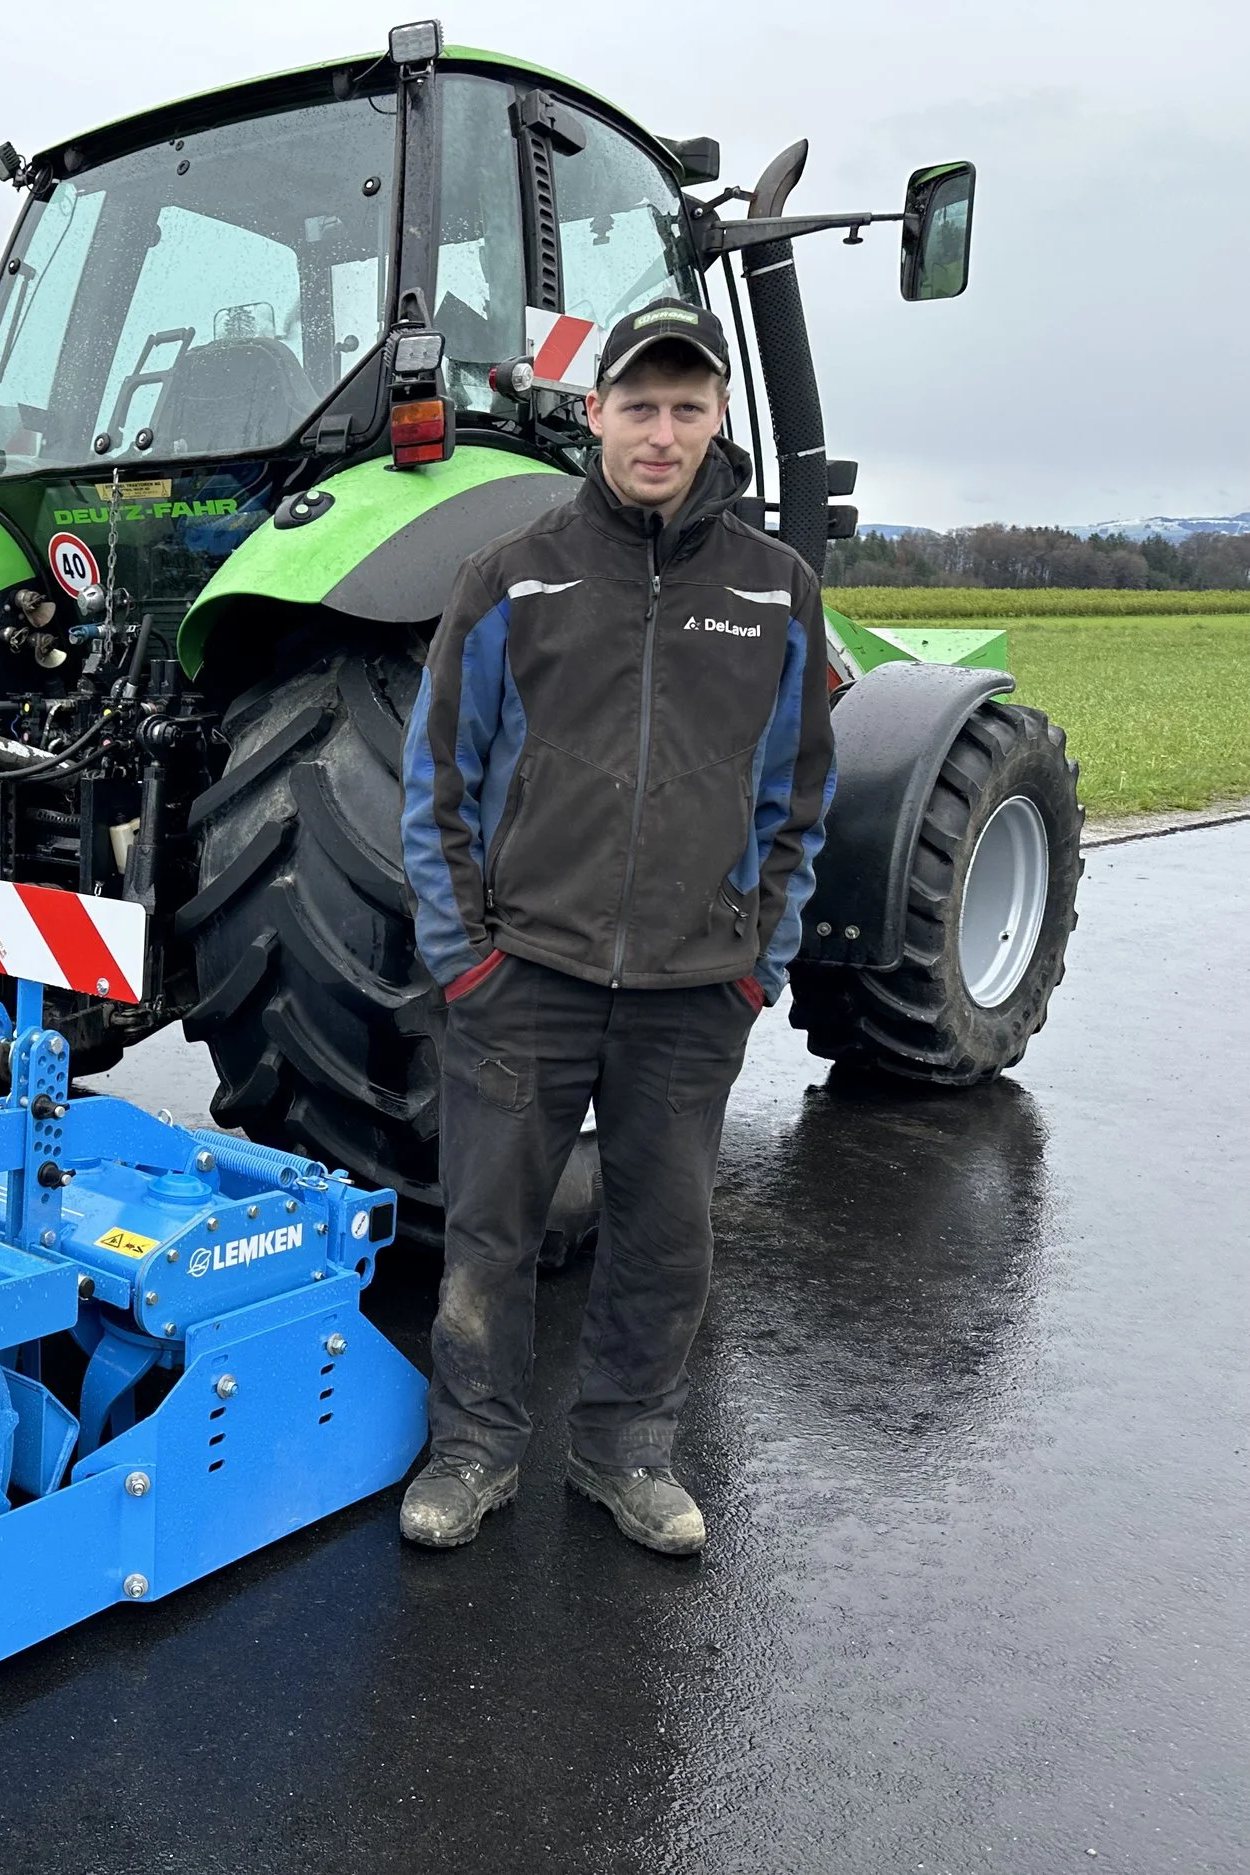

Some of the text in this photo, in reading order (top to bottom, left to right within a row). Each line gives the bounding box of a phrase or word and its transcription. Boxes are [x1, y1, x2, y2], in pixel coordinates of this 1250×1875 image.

[63, 553, 86, 579] 40
[704, 618, 761, 637] DeLaval
[213, 1223, 303, 1271] LEMKEN
